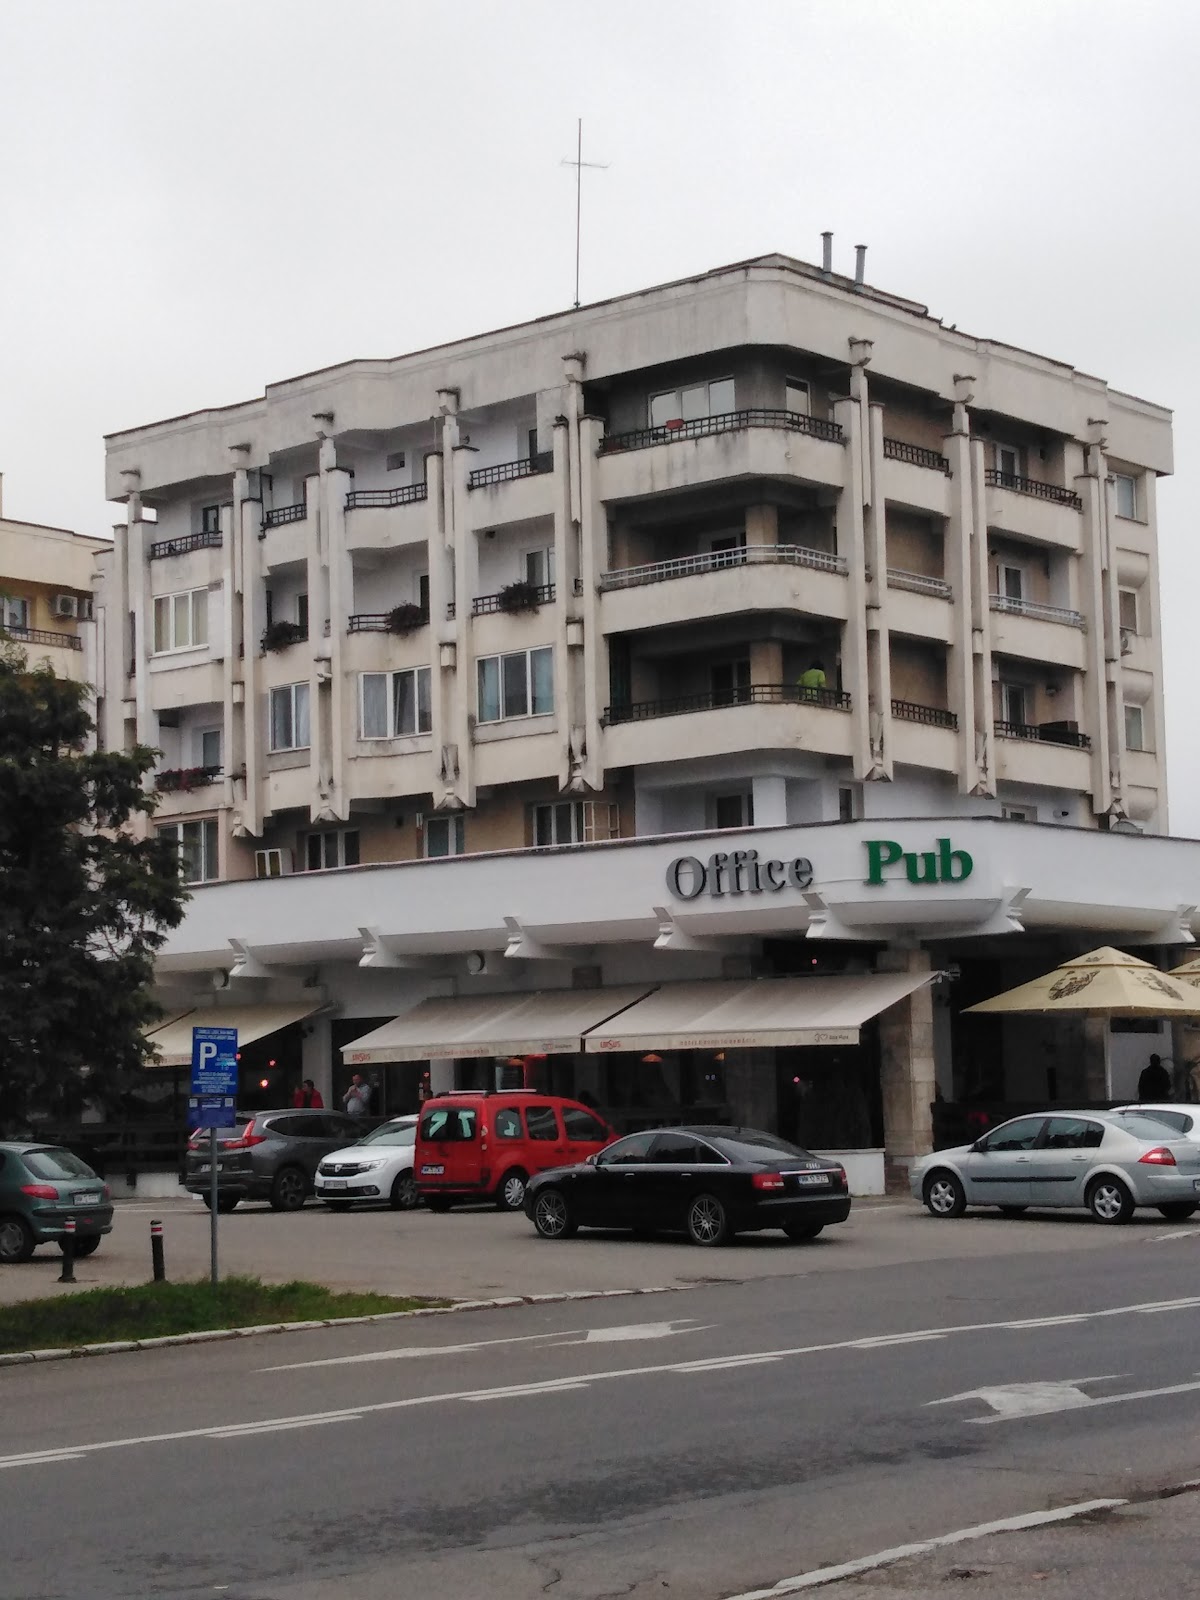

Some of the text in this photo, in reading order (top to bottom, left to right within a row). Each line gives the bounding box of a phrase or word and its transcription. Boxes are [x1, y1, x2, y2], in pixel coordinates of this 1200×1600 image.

[666, 838, 973, 900] Office Pub
[199, 1041, 218, 1070] P
